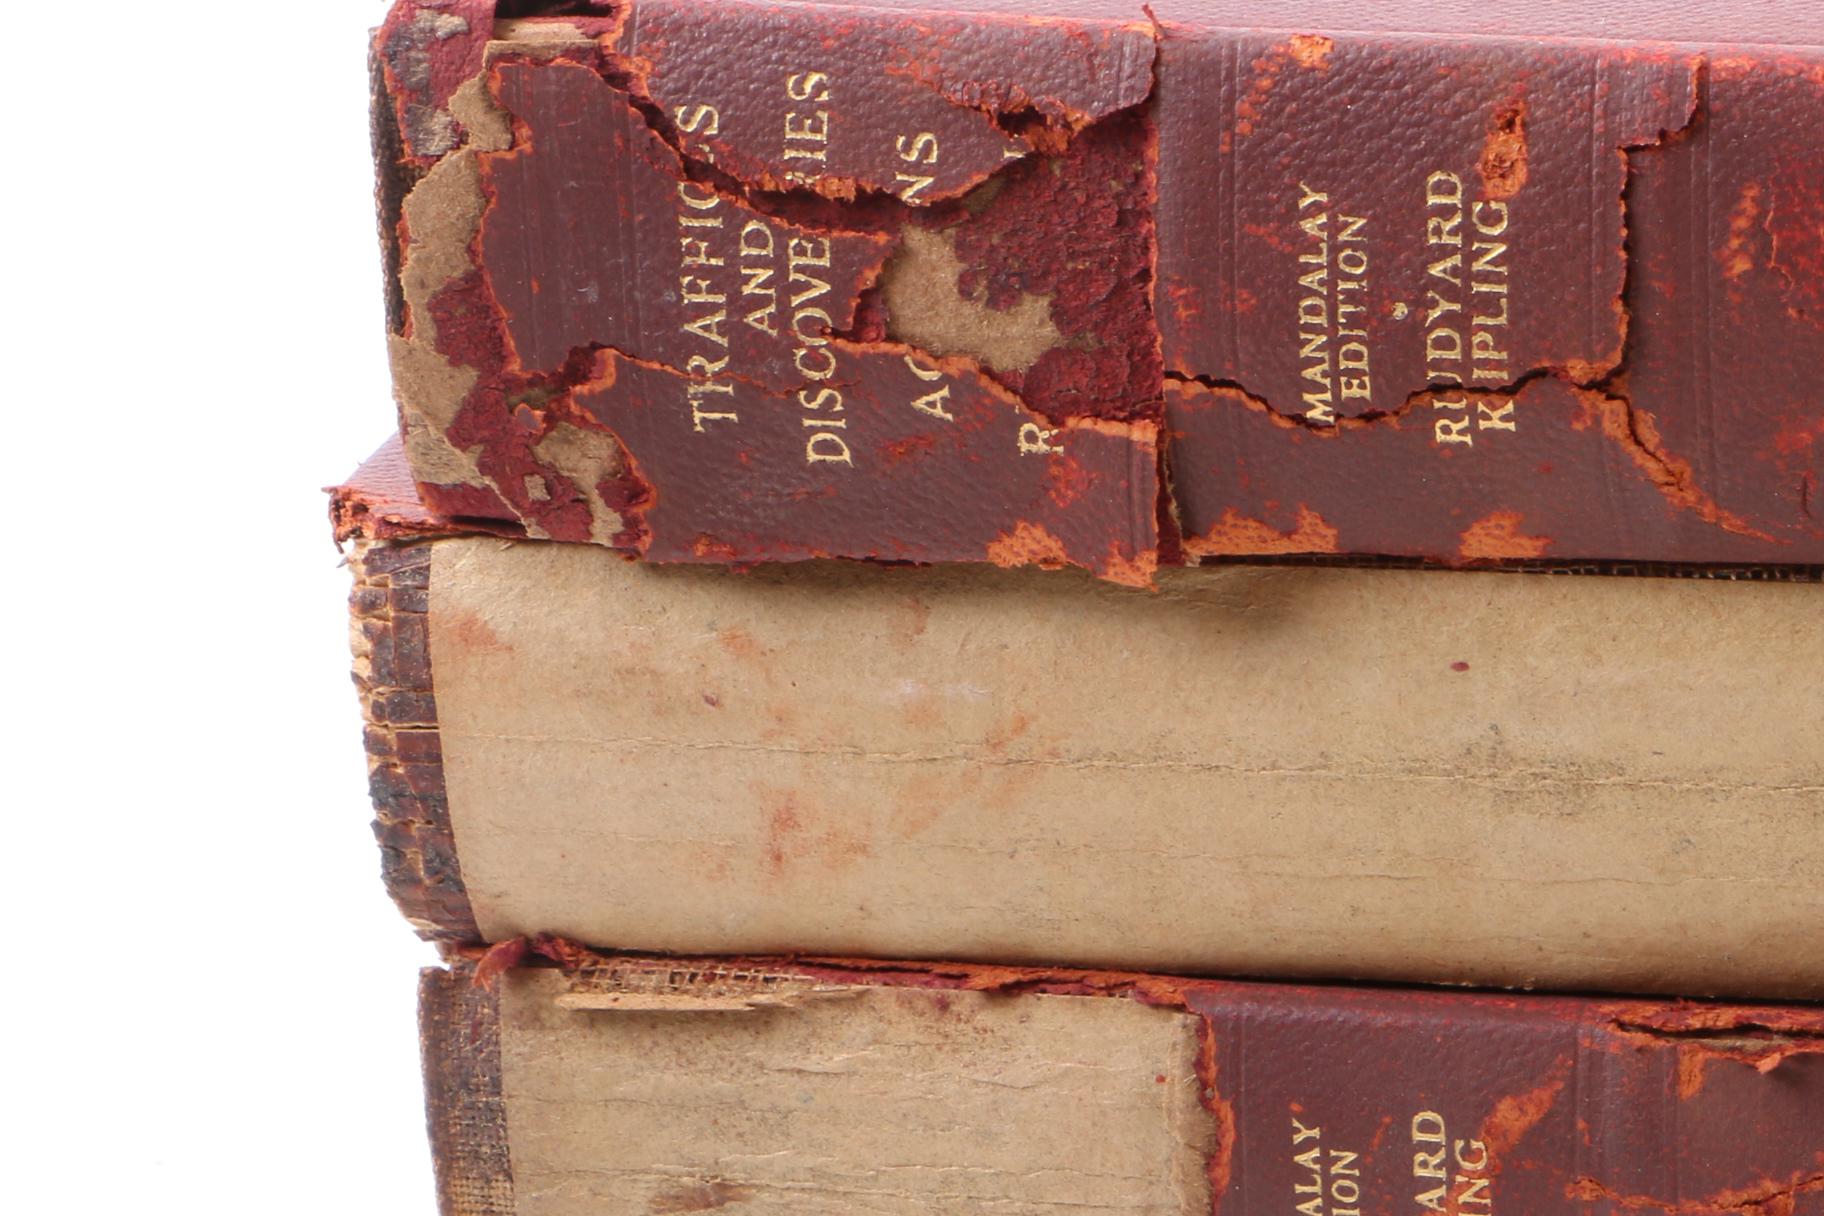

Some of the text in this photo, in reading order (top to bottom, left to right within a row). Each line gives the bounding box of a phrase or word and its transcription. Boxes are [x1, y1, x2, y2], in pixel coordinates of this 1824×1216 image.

[674, 102, 738, 432] TRAFFICS
[739, 219, 778, 337] AND
[896, 131, 953, 422] ACNS
[1298, 180, 1334, 424] MANDALAY
[1337, 214, 1372, 401] EDITION
[1426, 170, 1473, 446] RUDYARD
[1472, 200, 1516, 432] KIPLING
